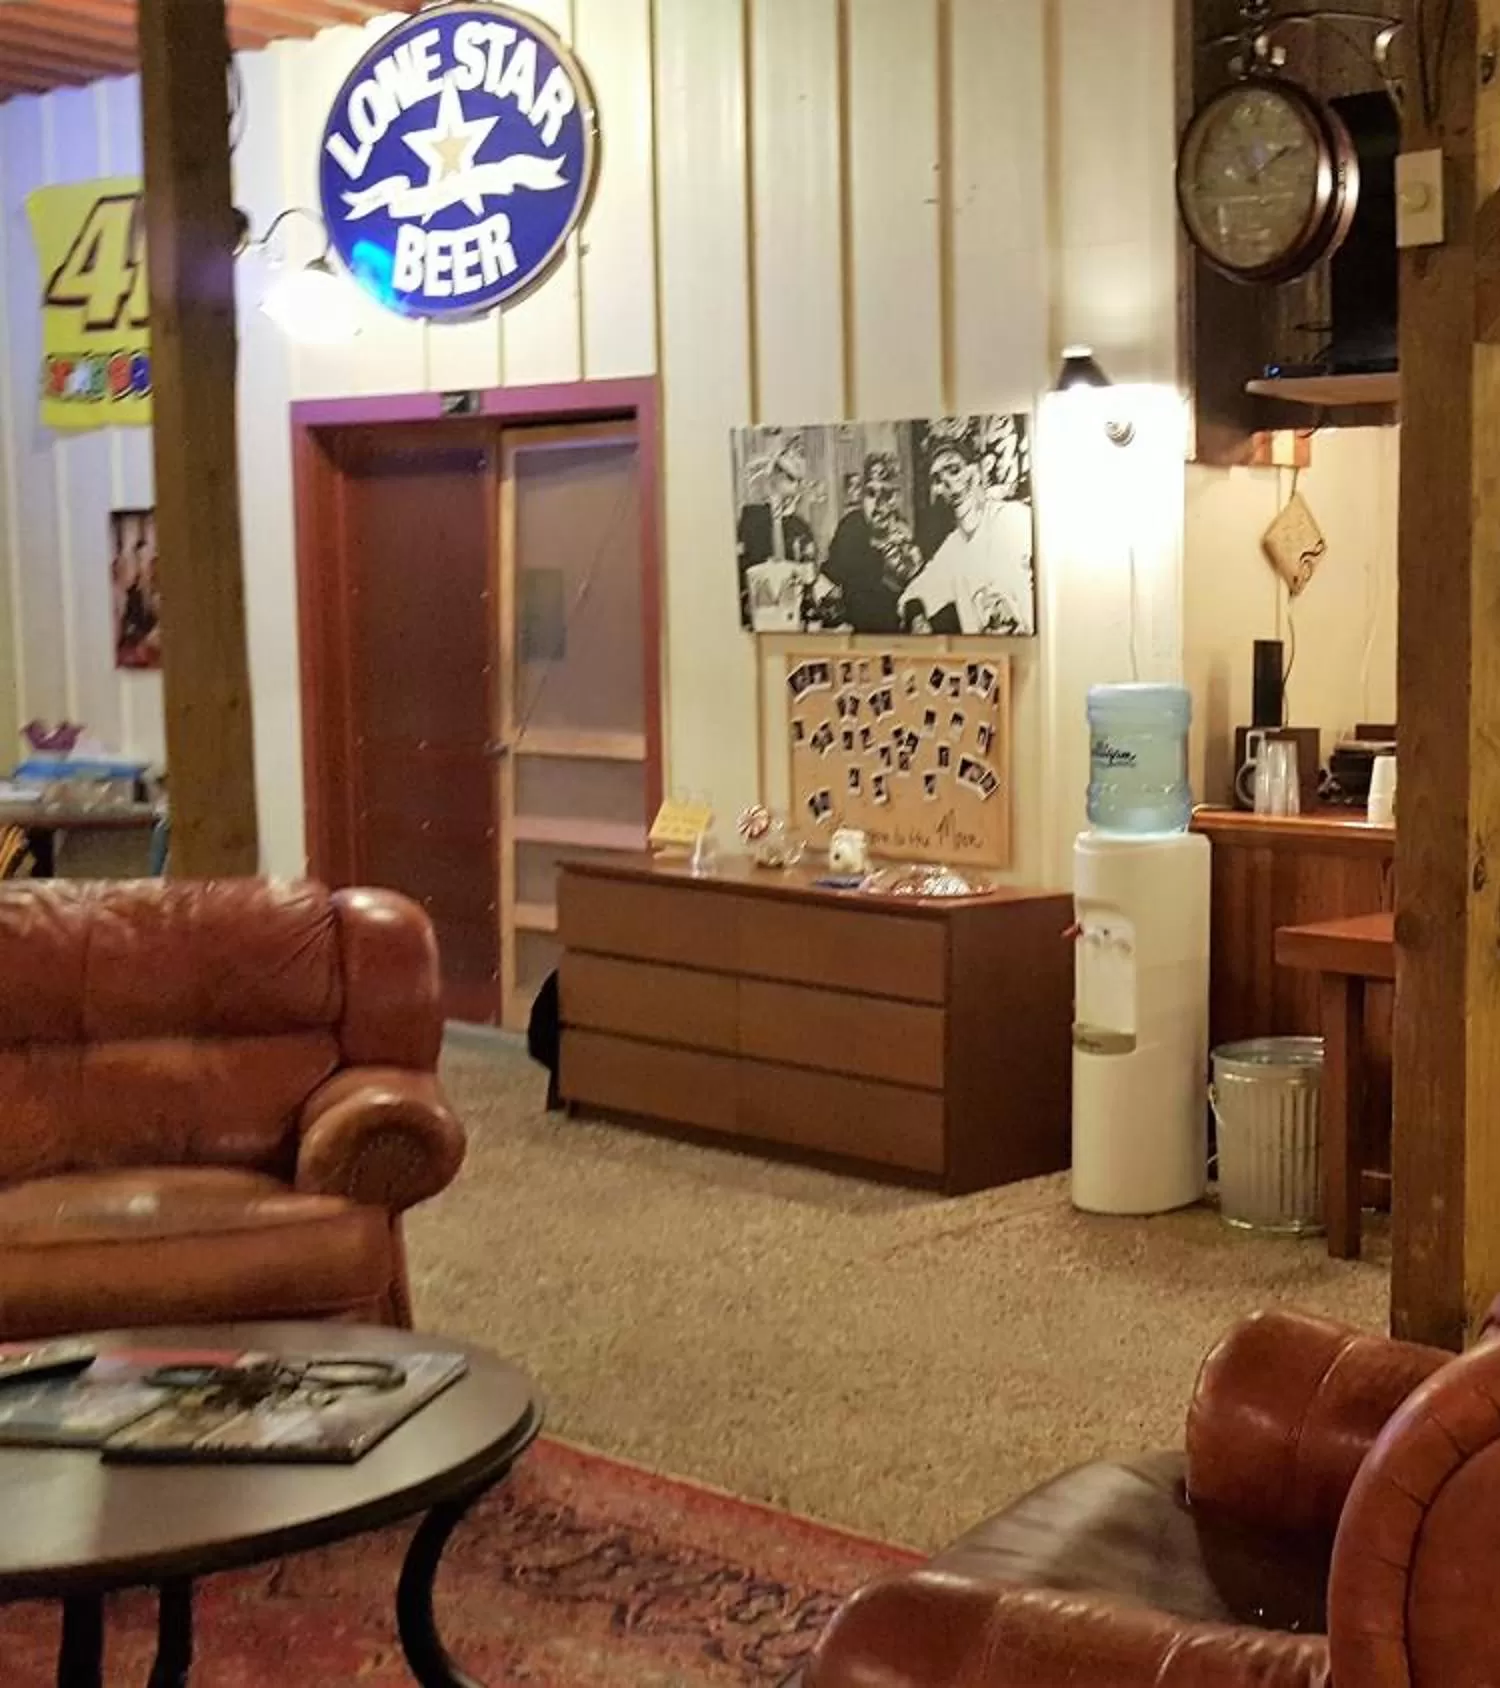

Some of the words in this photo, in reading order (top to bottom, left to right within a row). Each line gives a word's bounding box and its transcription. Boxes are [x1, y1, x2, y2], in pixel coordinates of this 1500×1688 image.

[325, 29, 445, 180] LONE
[453, 21, 576, 148] STAR
[392, 213, 519, 297] BEER
